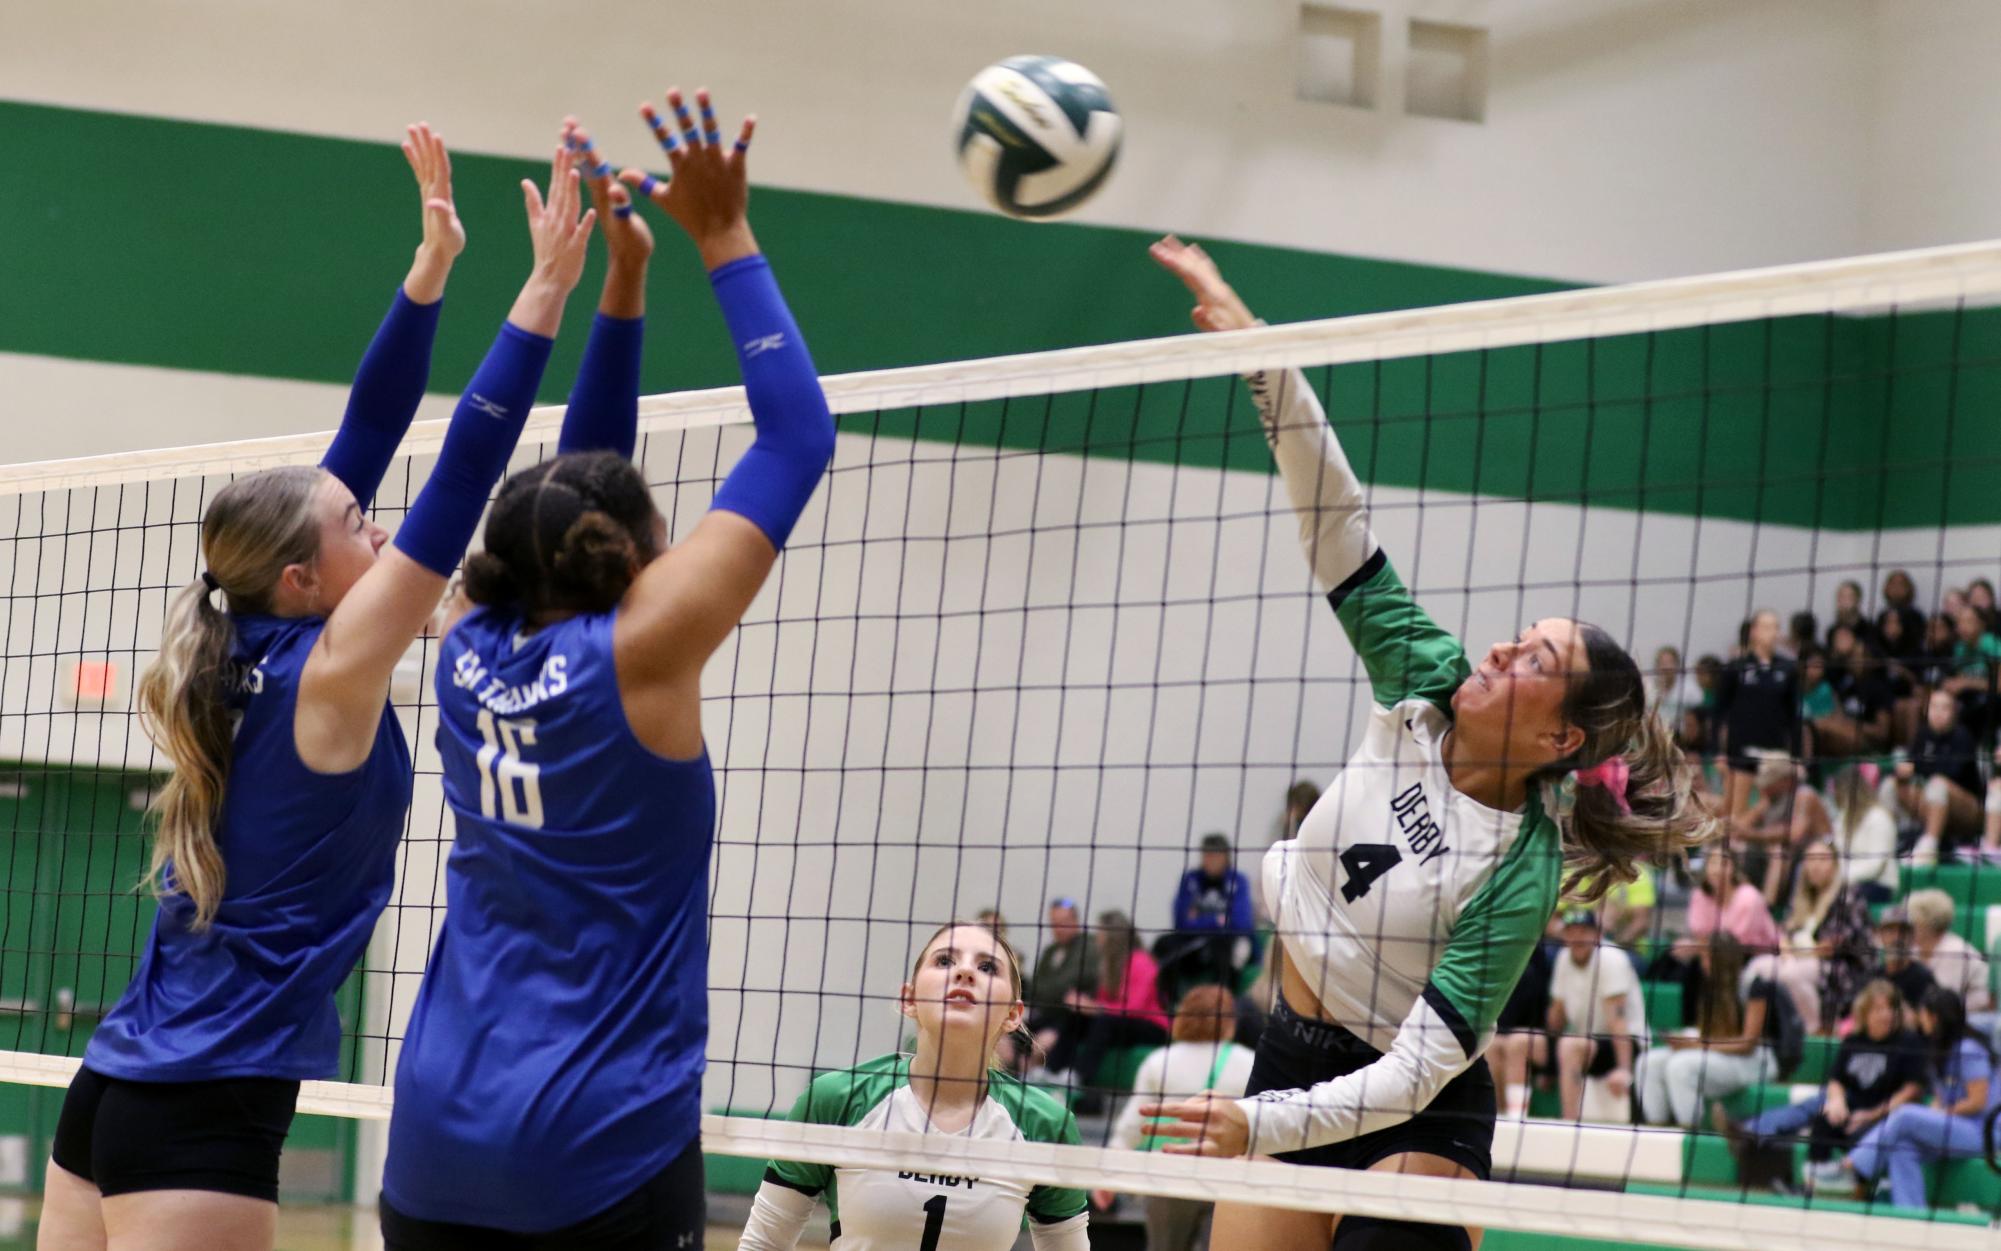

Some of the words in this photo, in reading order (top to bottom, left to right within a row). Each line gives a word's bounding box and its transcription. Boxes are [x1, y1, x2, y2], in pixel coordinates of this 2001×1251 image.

[476, 708, 544, 829] 16
[1391, 782, 1450, 866] DERBY
[1339, 843, 1403, 904] 4
[920, 1194, 948, 1251] 1
